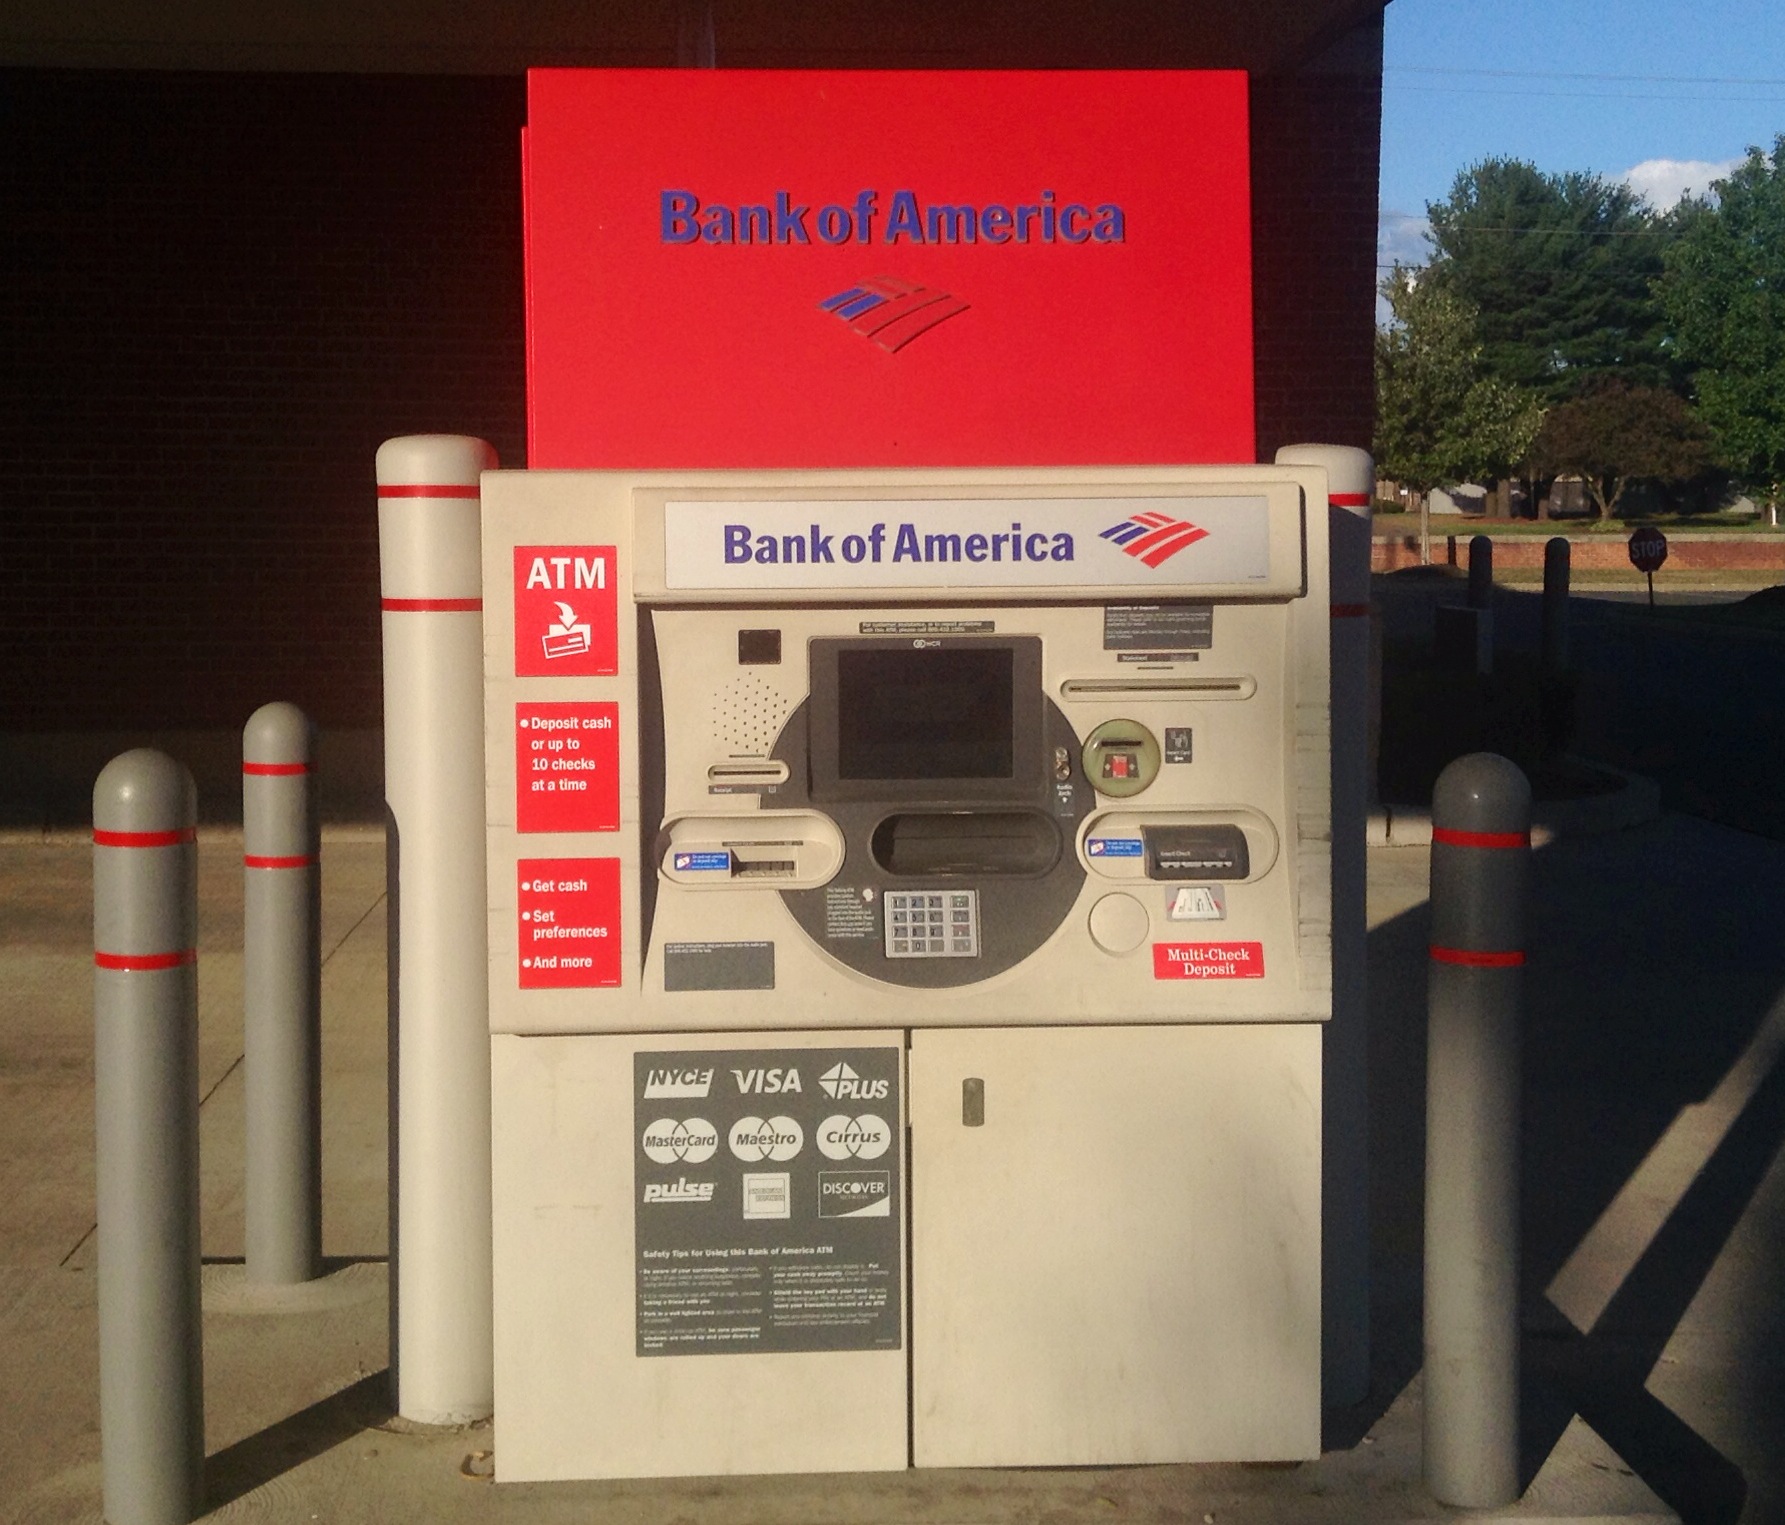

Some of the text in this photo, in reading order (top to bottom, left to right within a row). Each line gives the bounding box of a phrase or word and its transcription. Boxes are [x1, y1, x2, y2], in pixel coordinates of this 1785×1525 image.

[661, 190, 1126, 246] Bank of America
[723, 522, 1074, 564] Bank of America
[1631, 539, 1665, 559] STOP
[526, 557, 606, 590] ATM
[531, 716, 612, 732] Deposit cash
[531, 738, 581, 753] or up to
[532, 758, 596, 771] 10 checks
[531, 778, 588, 791] at a time
[533, 879, 589, 892] Get cash
[533, 910, 556, 922] Set
[533, 926, 608, 941] preferences
[533, 956, 593, 968] And more
[1168, 948, 1251, 962] Multi-Check
[1184, 962, 1236, 977] Deposit
[648, 1068, 714, 1088] NYCE
[730, 1068, 803, 1094] VISA
[837, 1080, 889, 1100] PLUS
[645, 1134, 715, 1148] MasterCard
[736, 1132, 796, 1146] Maestro
[826, 1131, 881, 1144] Cirrus
[644, 1177, 714, 1203] pulse
[822, 1182, 885, 1195] DISCOVER
[643, 1246, 834, 1259] Safety Tips for Using this Bank of America ATM
